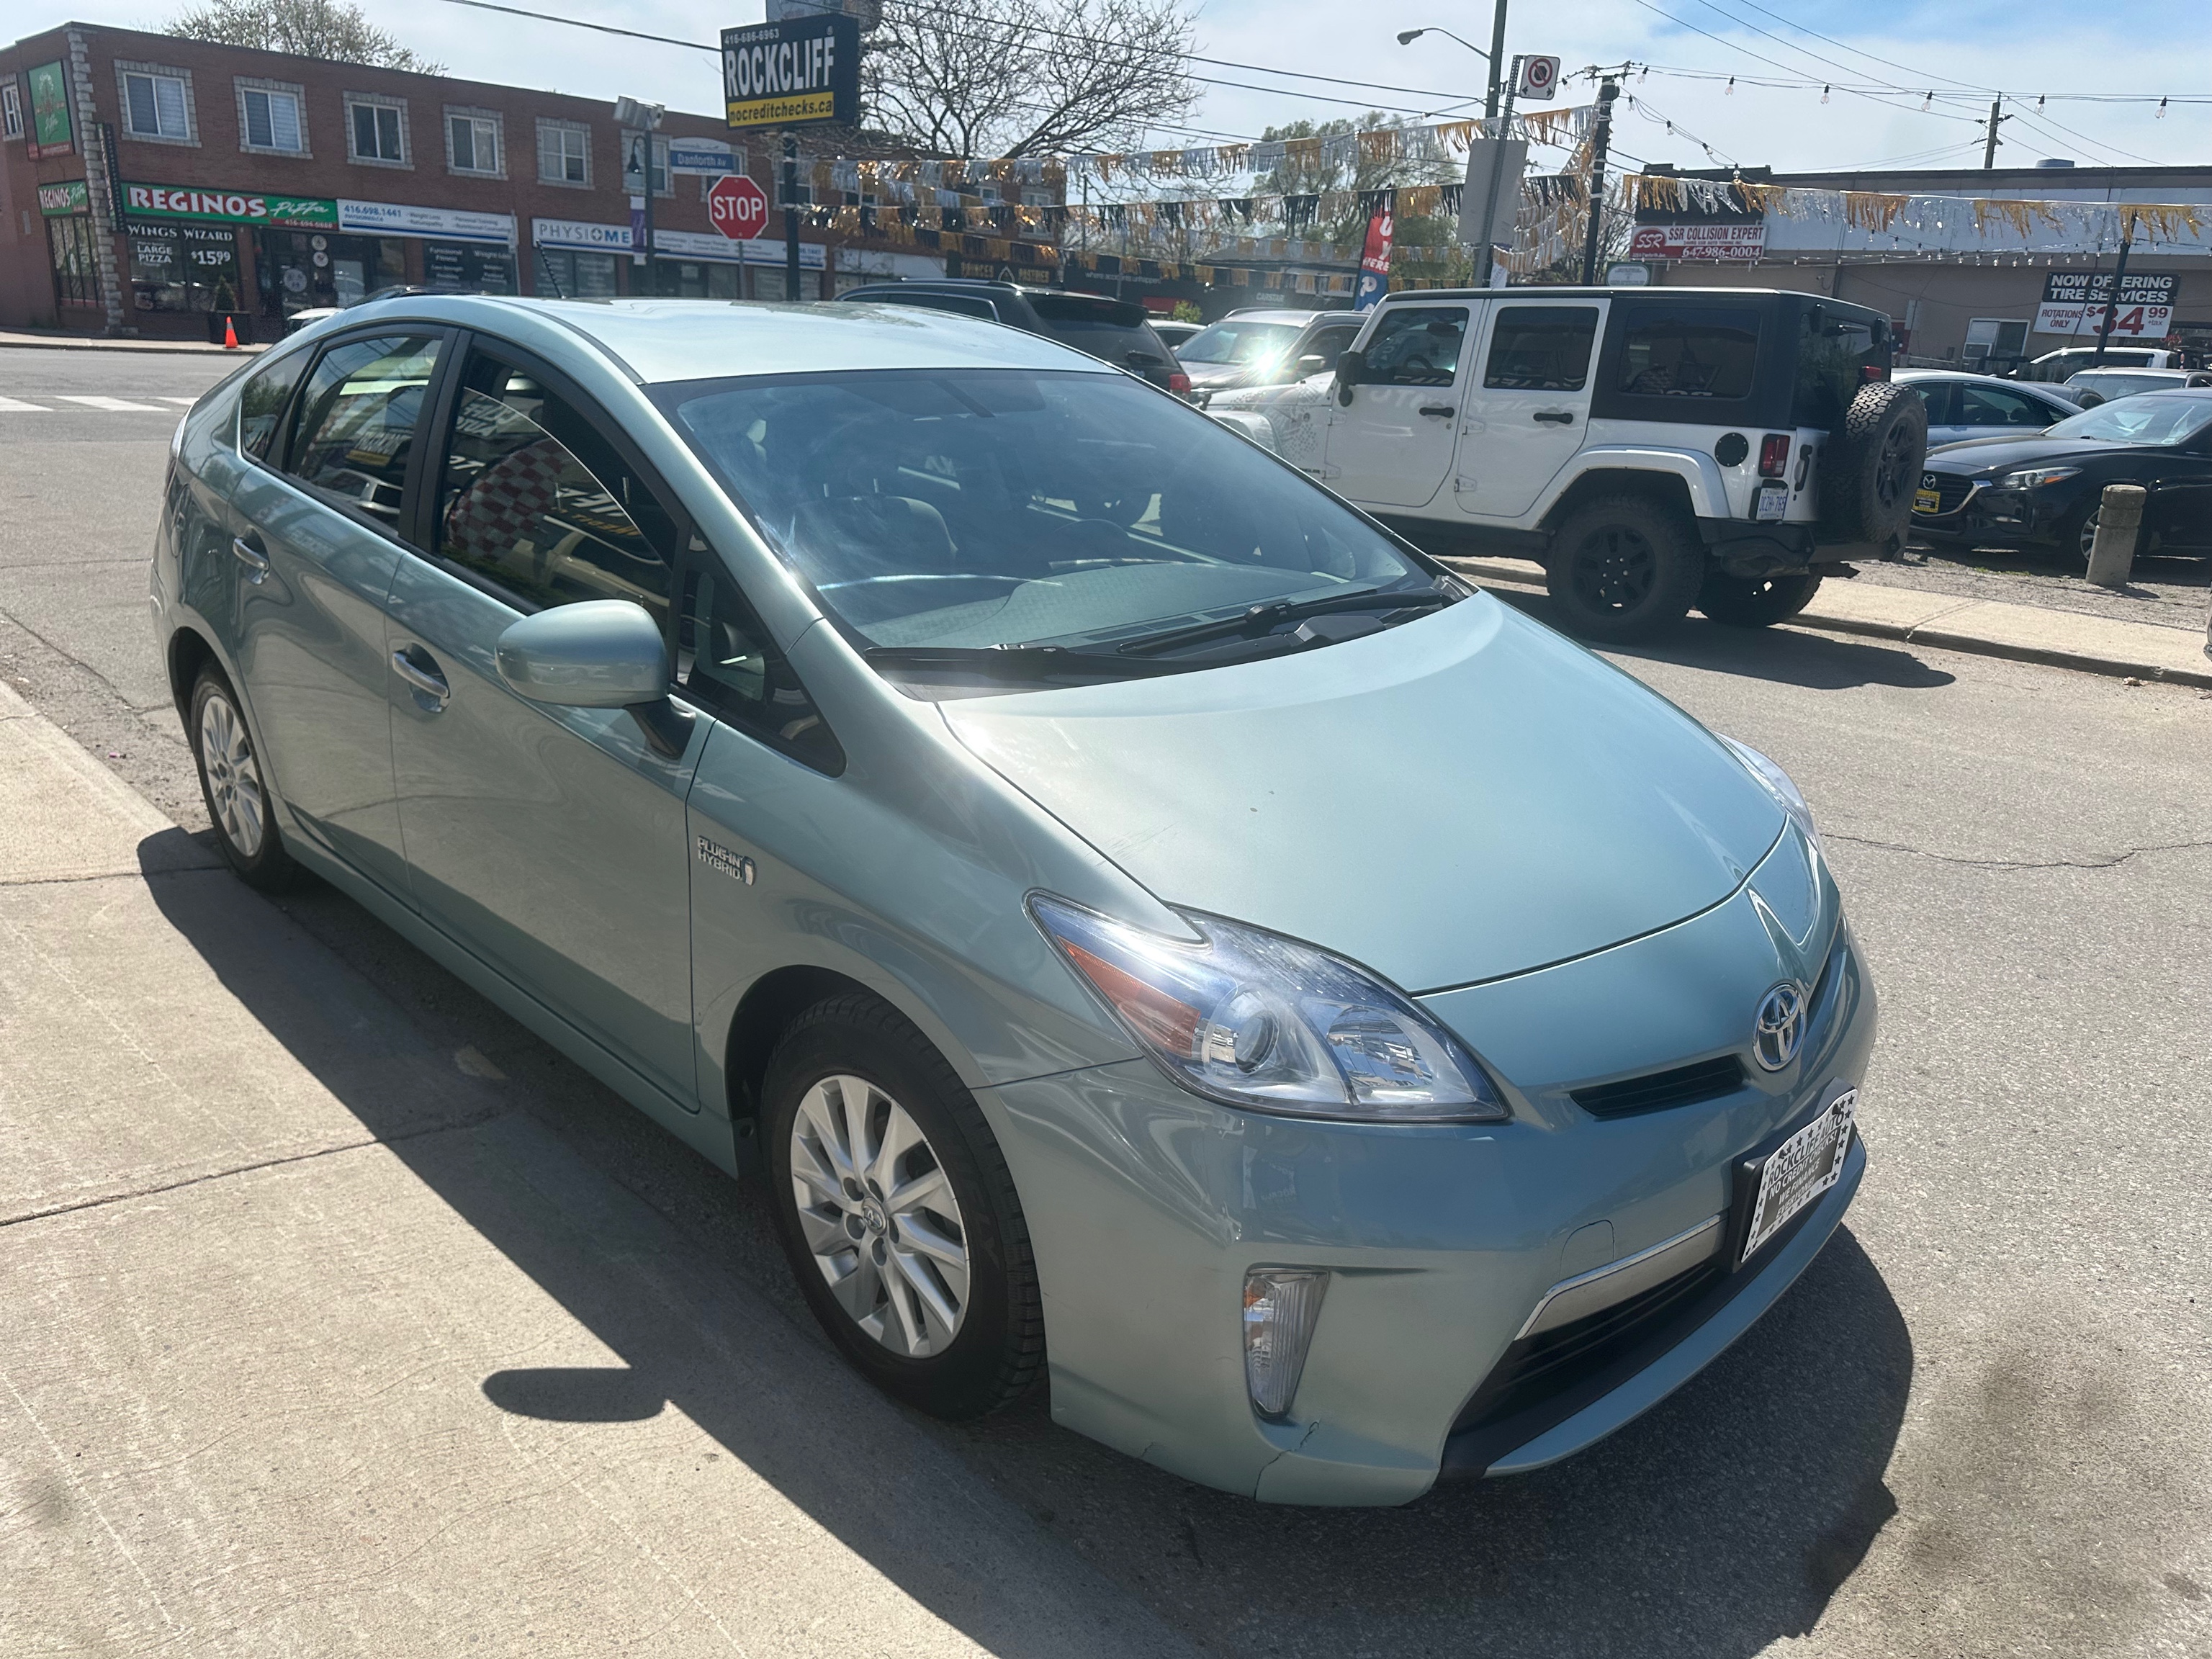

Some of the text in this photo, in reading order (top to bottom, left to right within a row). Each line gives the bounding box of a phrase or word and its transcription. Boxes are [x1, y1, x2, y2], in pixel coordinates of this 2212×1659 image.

[725, 36, 835, 97] ROCKCLIFF
[729, 99, 832, 122] nocreditchecks.ca
[677, 153, 716, 168] Danforth
[39, 186, 71, 209] REGINOS
[129, 186, 329, 217] REGINOS Pizza
[344, 205, 402, 217] 416.698.1441
[713, 195, 763, 221] STOP
[127, 224, 178, 238] WINGS
[183, 227, 233, 241] WIZARD
[1668, 227, 1763, 240] SSR COLLISION EXPERT
[1636, 234, 1664, 248] SSR
[137, 245, 173, 255] LARGE
[1682, 246, 1761, 257] 647-986-0004
[138, 253, 173, 264] PIZZA
[1362, 257, 1390, 271] HERE
[2051, 275, 2173, 288] NOW OFERING
[2051, 288, 2168, 302] TIRE SEVICES
[2041, 309, 2083, 319] ROTATIONS
[697, 836, 742, 868] PLUG-IN
[698, 850, 741, 880] HYBRID
[1768, 1111, 1845, 1188] ROCKCLIFF AUTO
[1769, 1182, 1781, 1200] NO
[1782, 1158, 1810, 1187] CREDIT
[1779, 1157, 1821, 1205] WE FINANCE
